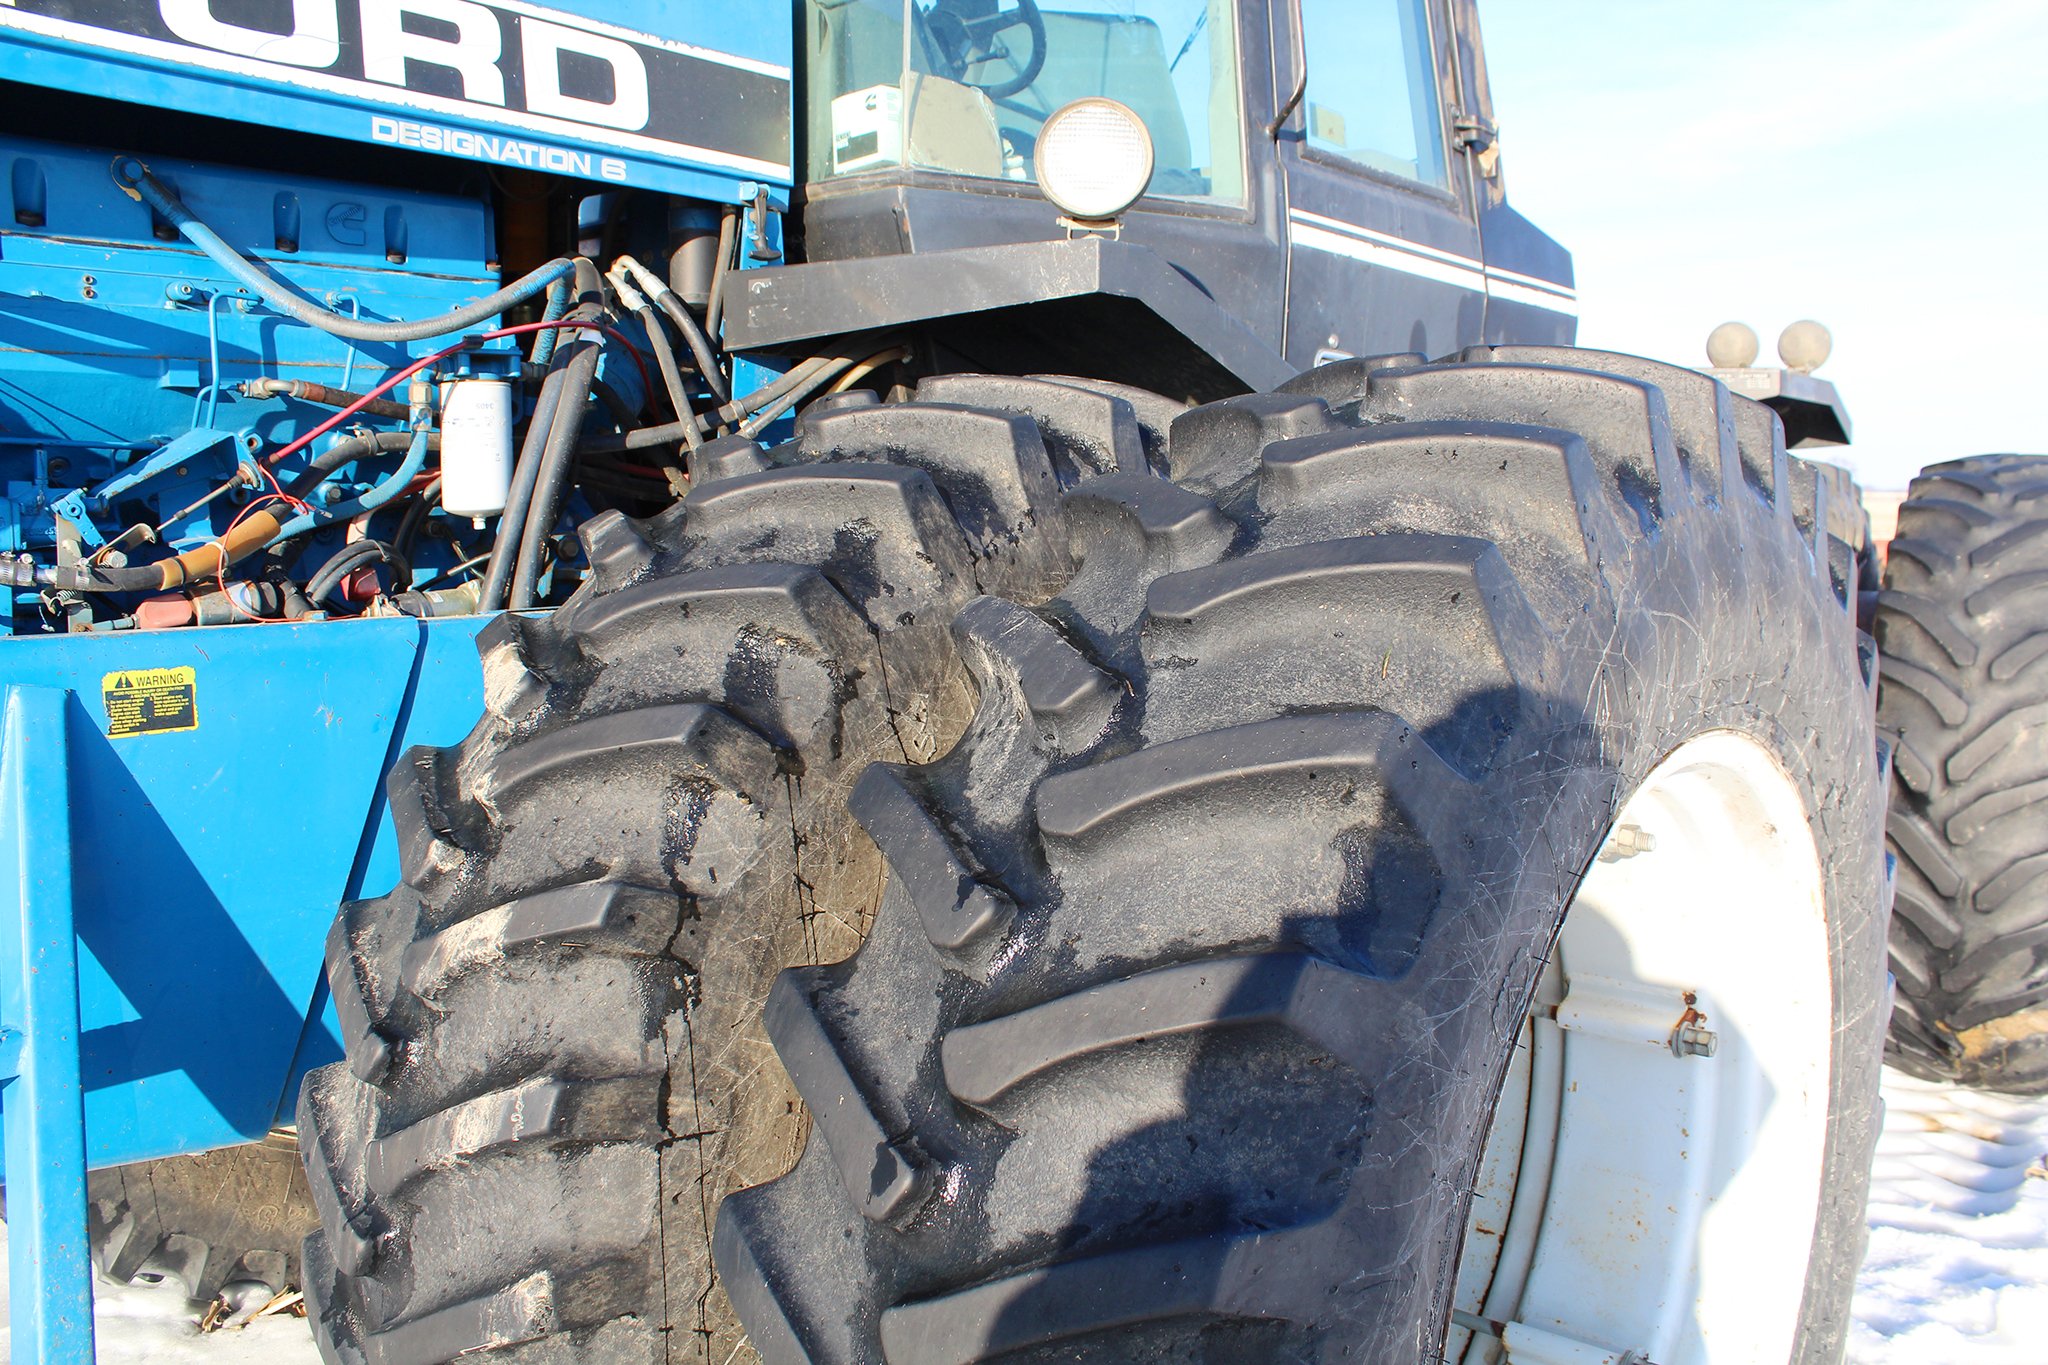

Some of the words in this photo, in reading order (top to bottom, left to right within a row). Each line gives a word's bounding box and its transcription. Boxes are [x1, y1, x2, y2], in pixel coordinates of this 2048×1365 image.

[0, 0, 649, 131] ORD
[372, 116, 591, 176] DESIGNATION
[601, 158, 627, 181] 6
[136, 673, 184, 687] WARNING
